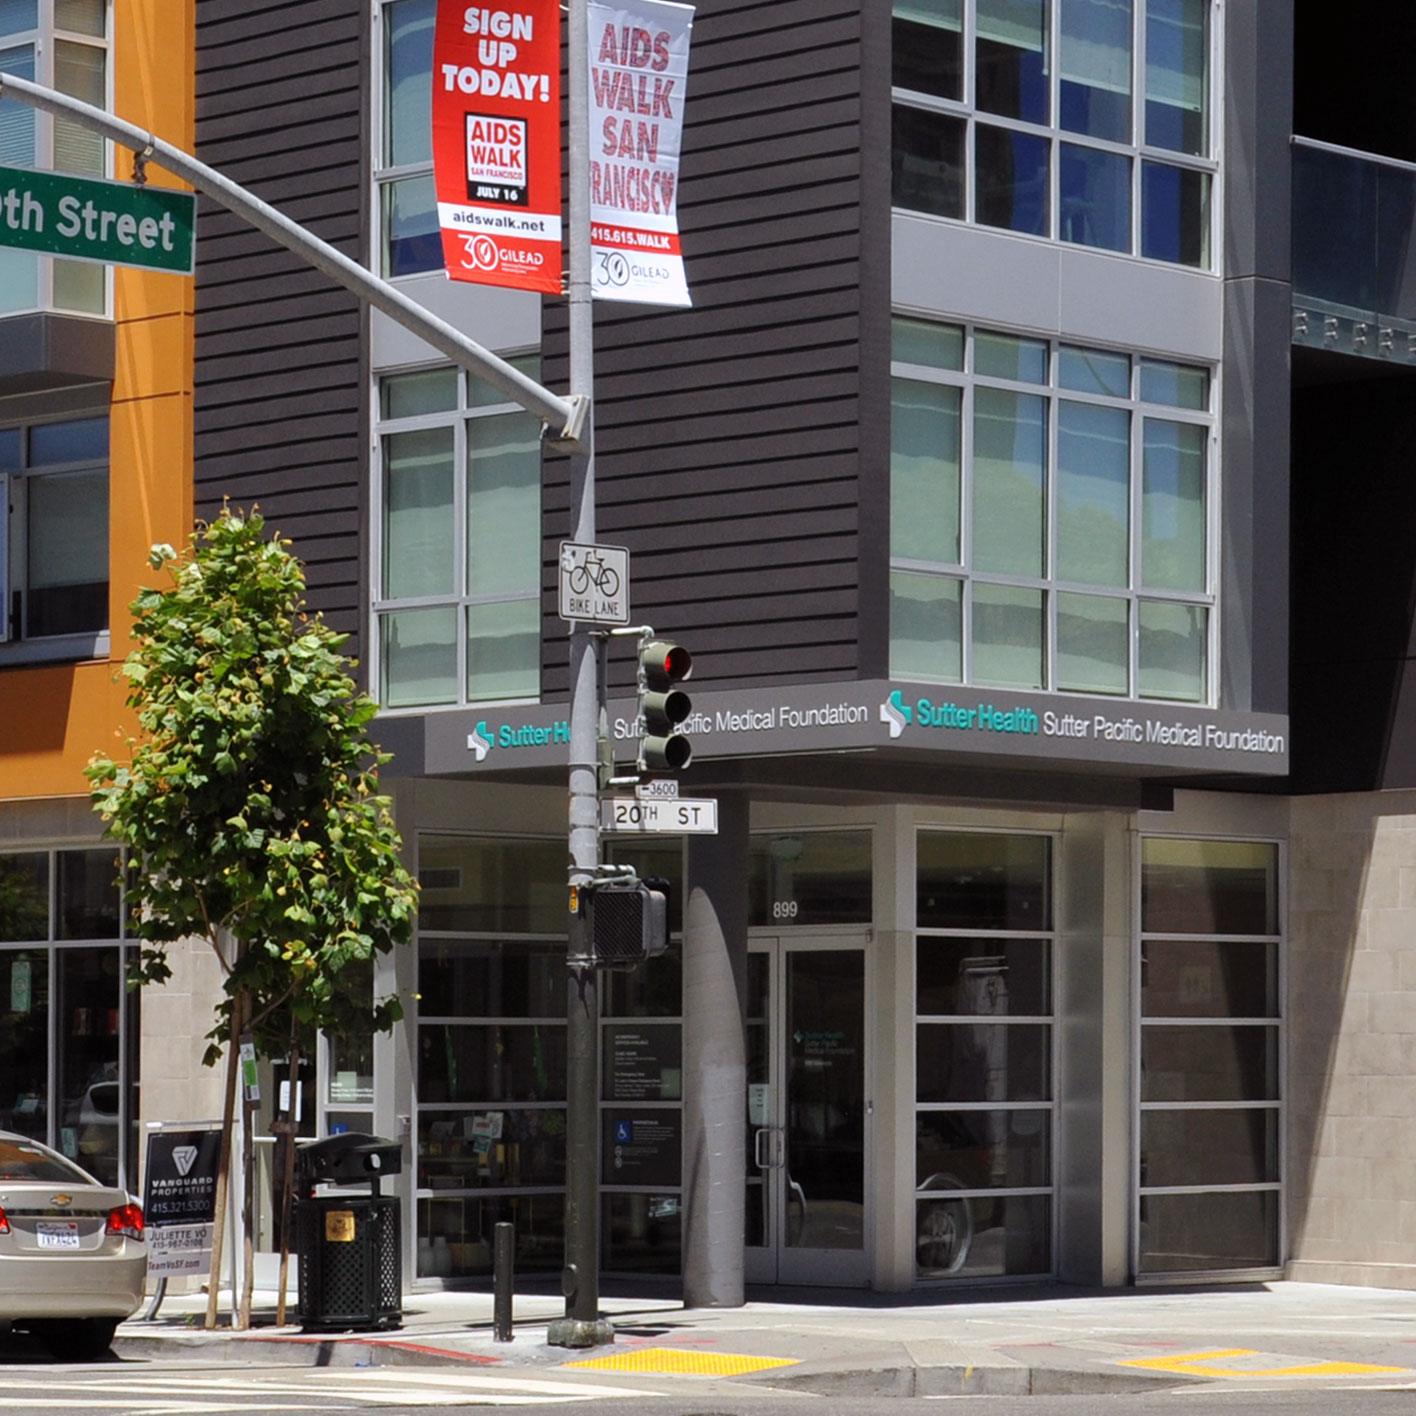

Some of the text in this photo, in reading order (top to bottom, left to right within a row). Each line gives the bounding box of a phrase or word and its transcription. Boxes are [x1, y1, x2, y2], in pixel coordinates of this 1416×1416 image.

[463, 7, 533, 41] SIGN
[478, 39, 517, 68] UP
[598, 23, 671, 72] AIDS
[442, 64, 550, 102] TODAY!
[591, 67, 675, 119] WALK
[471, 120, 522, 147] AIDS
[602, 115, 659, 163] SAN
[471, 145, 522, 169] WALK
[471, 167, 523, 181] SAN FRANCISCO
[476, 186, 518, 201] JULY 16
[56, 195, 176, 252] Street
[453, 212, 545, 232] aidswalk.net
[591, 227, 671, 249] 415.615.WALK
[499, 248, 544, 265] GILEAD
[631, 265, 670, 279] GILEAD
[569, 598, 620, 616] BIKE LANE
[673, 713, 712, 735] acific
[715, 707, 775, 732] Medical
[779, 702, 868, 728] Foundation
[917, 698, 1285, 753] Sutter Health Sutter Pacific Medical Foundation
[499, 724, 552, 748] Sutter
[616, 805, 701, 825] 20TH ST
[773, 901, 798, 918] 899
[151, 1185, 212, 1196] PROPERTIES
[152, 1177, 213, 1188] VANGUARD
[151, 1199, 210, 1214] 415.321.5300
[149, 1230, 192, 1242] JULIETTE
